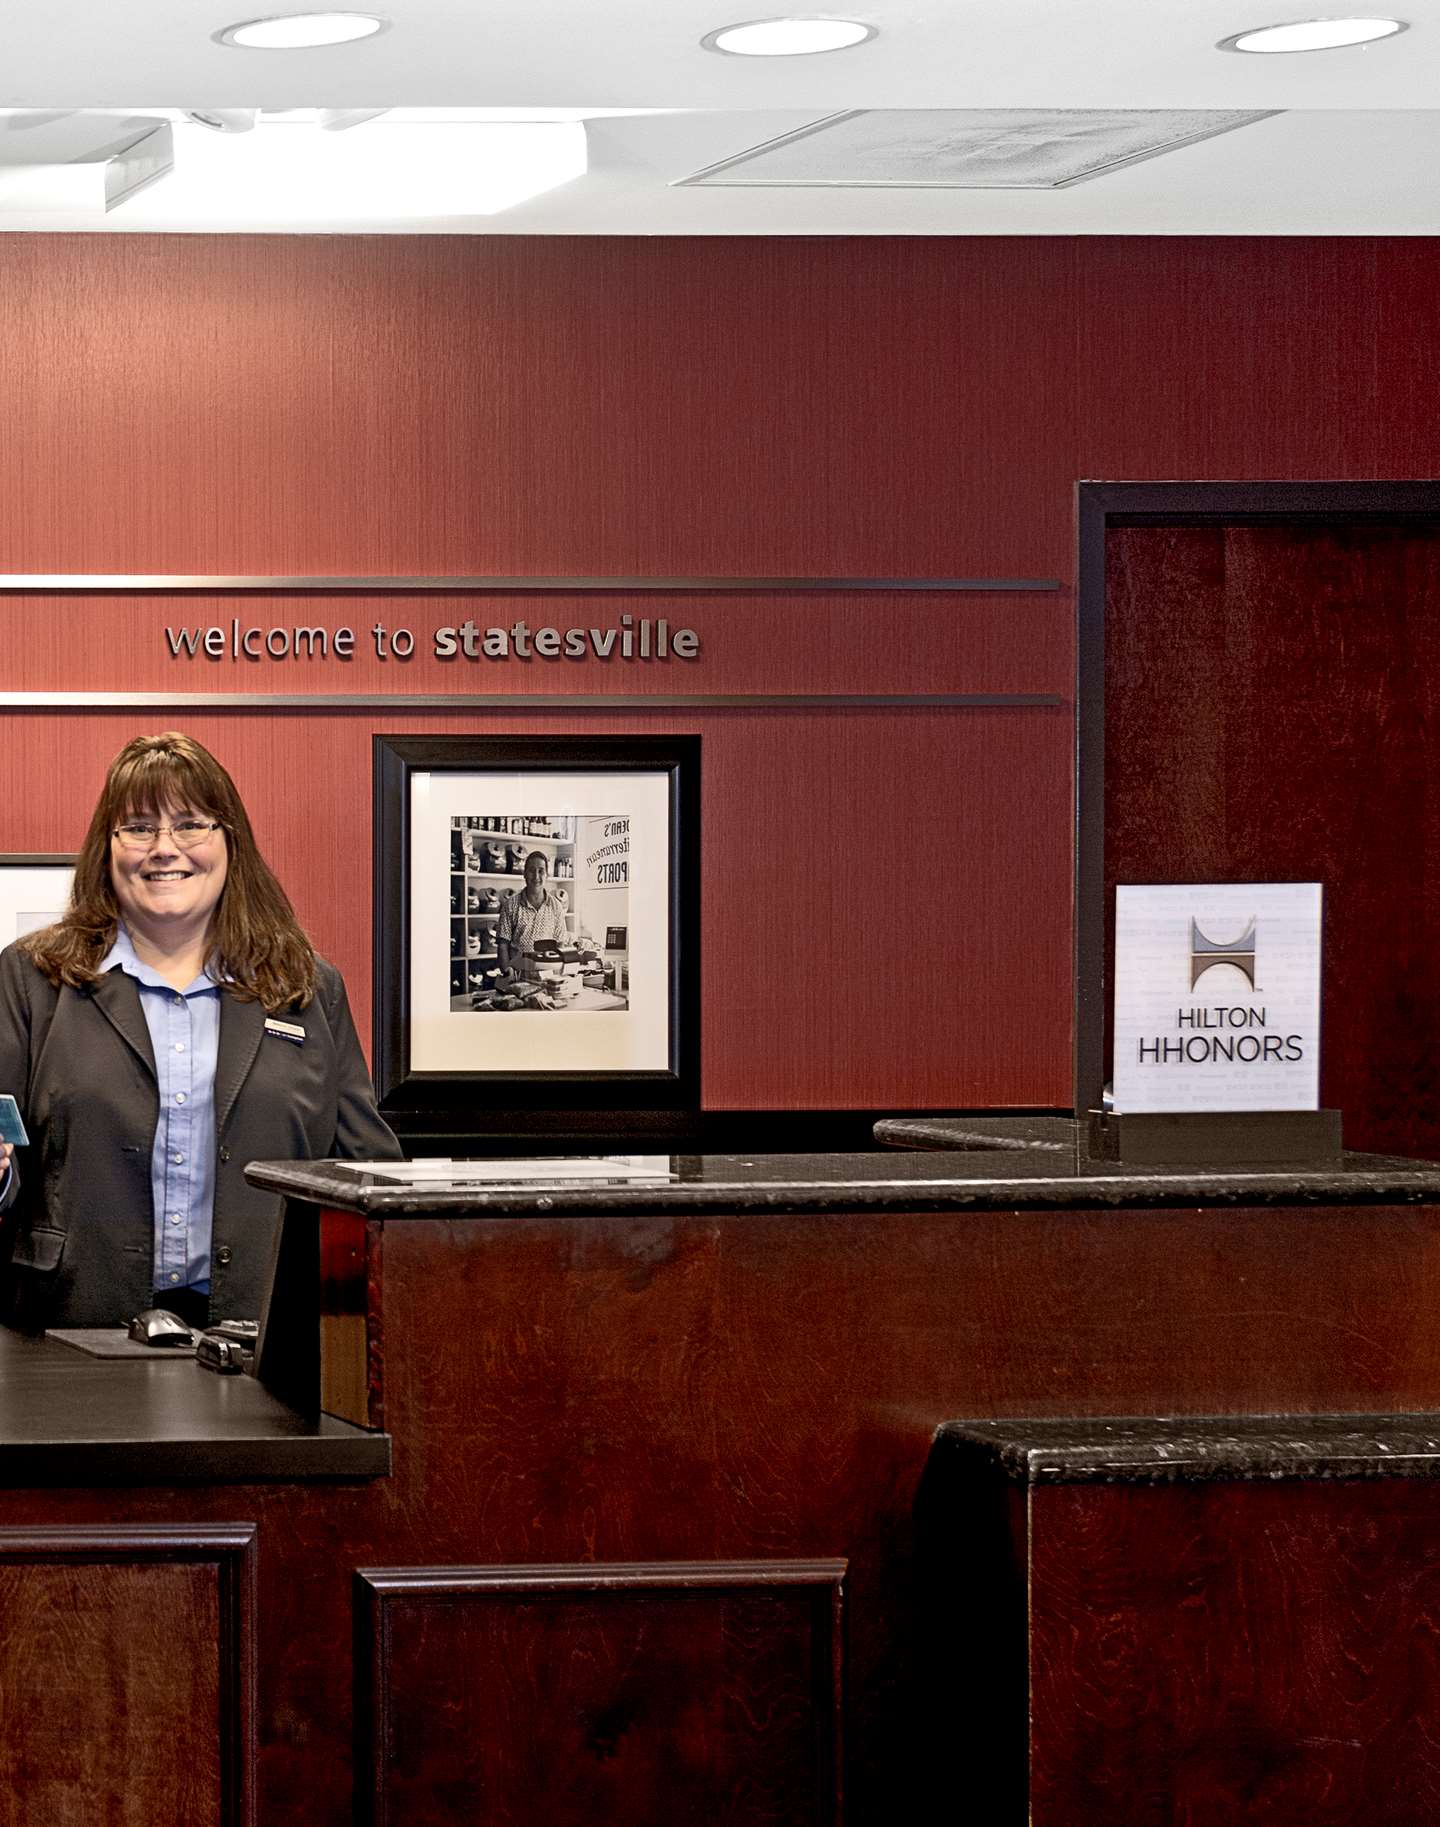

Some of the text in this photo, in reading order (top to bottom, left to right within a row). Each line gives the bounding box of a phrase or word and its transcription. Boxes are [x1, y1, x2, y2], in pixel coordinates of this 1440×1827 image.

[165, 615, 701, 659] welcome to statesville
[1178, 1007, 1266, 1028] HILTON
[1138, 1034, 1303, 1063] HHONORS
